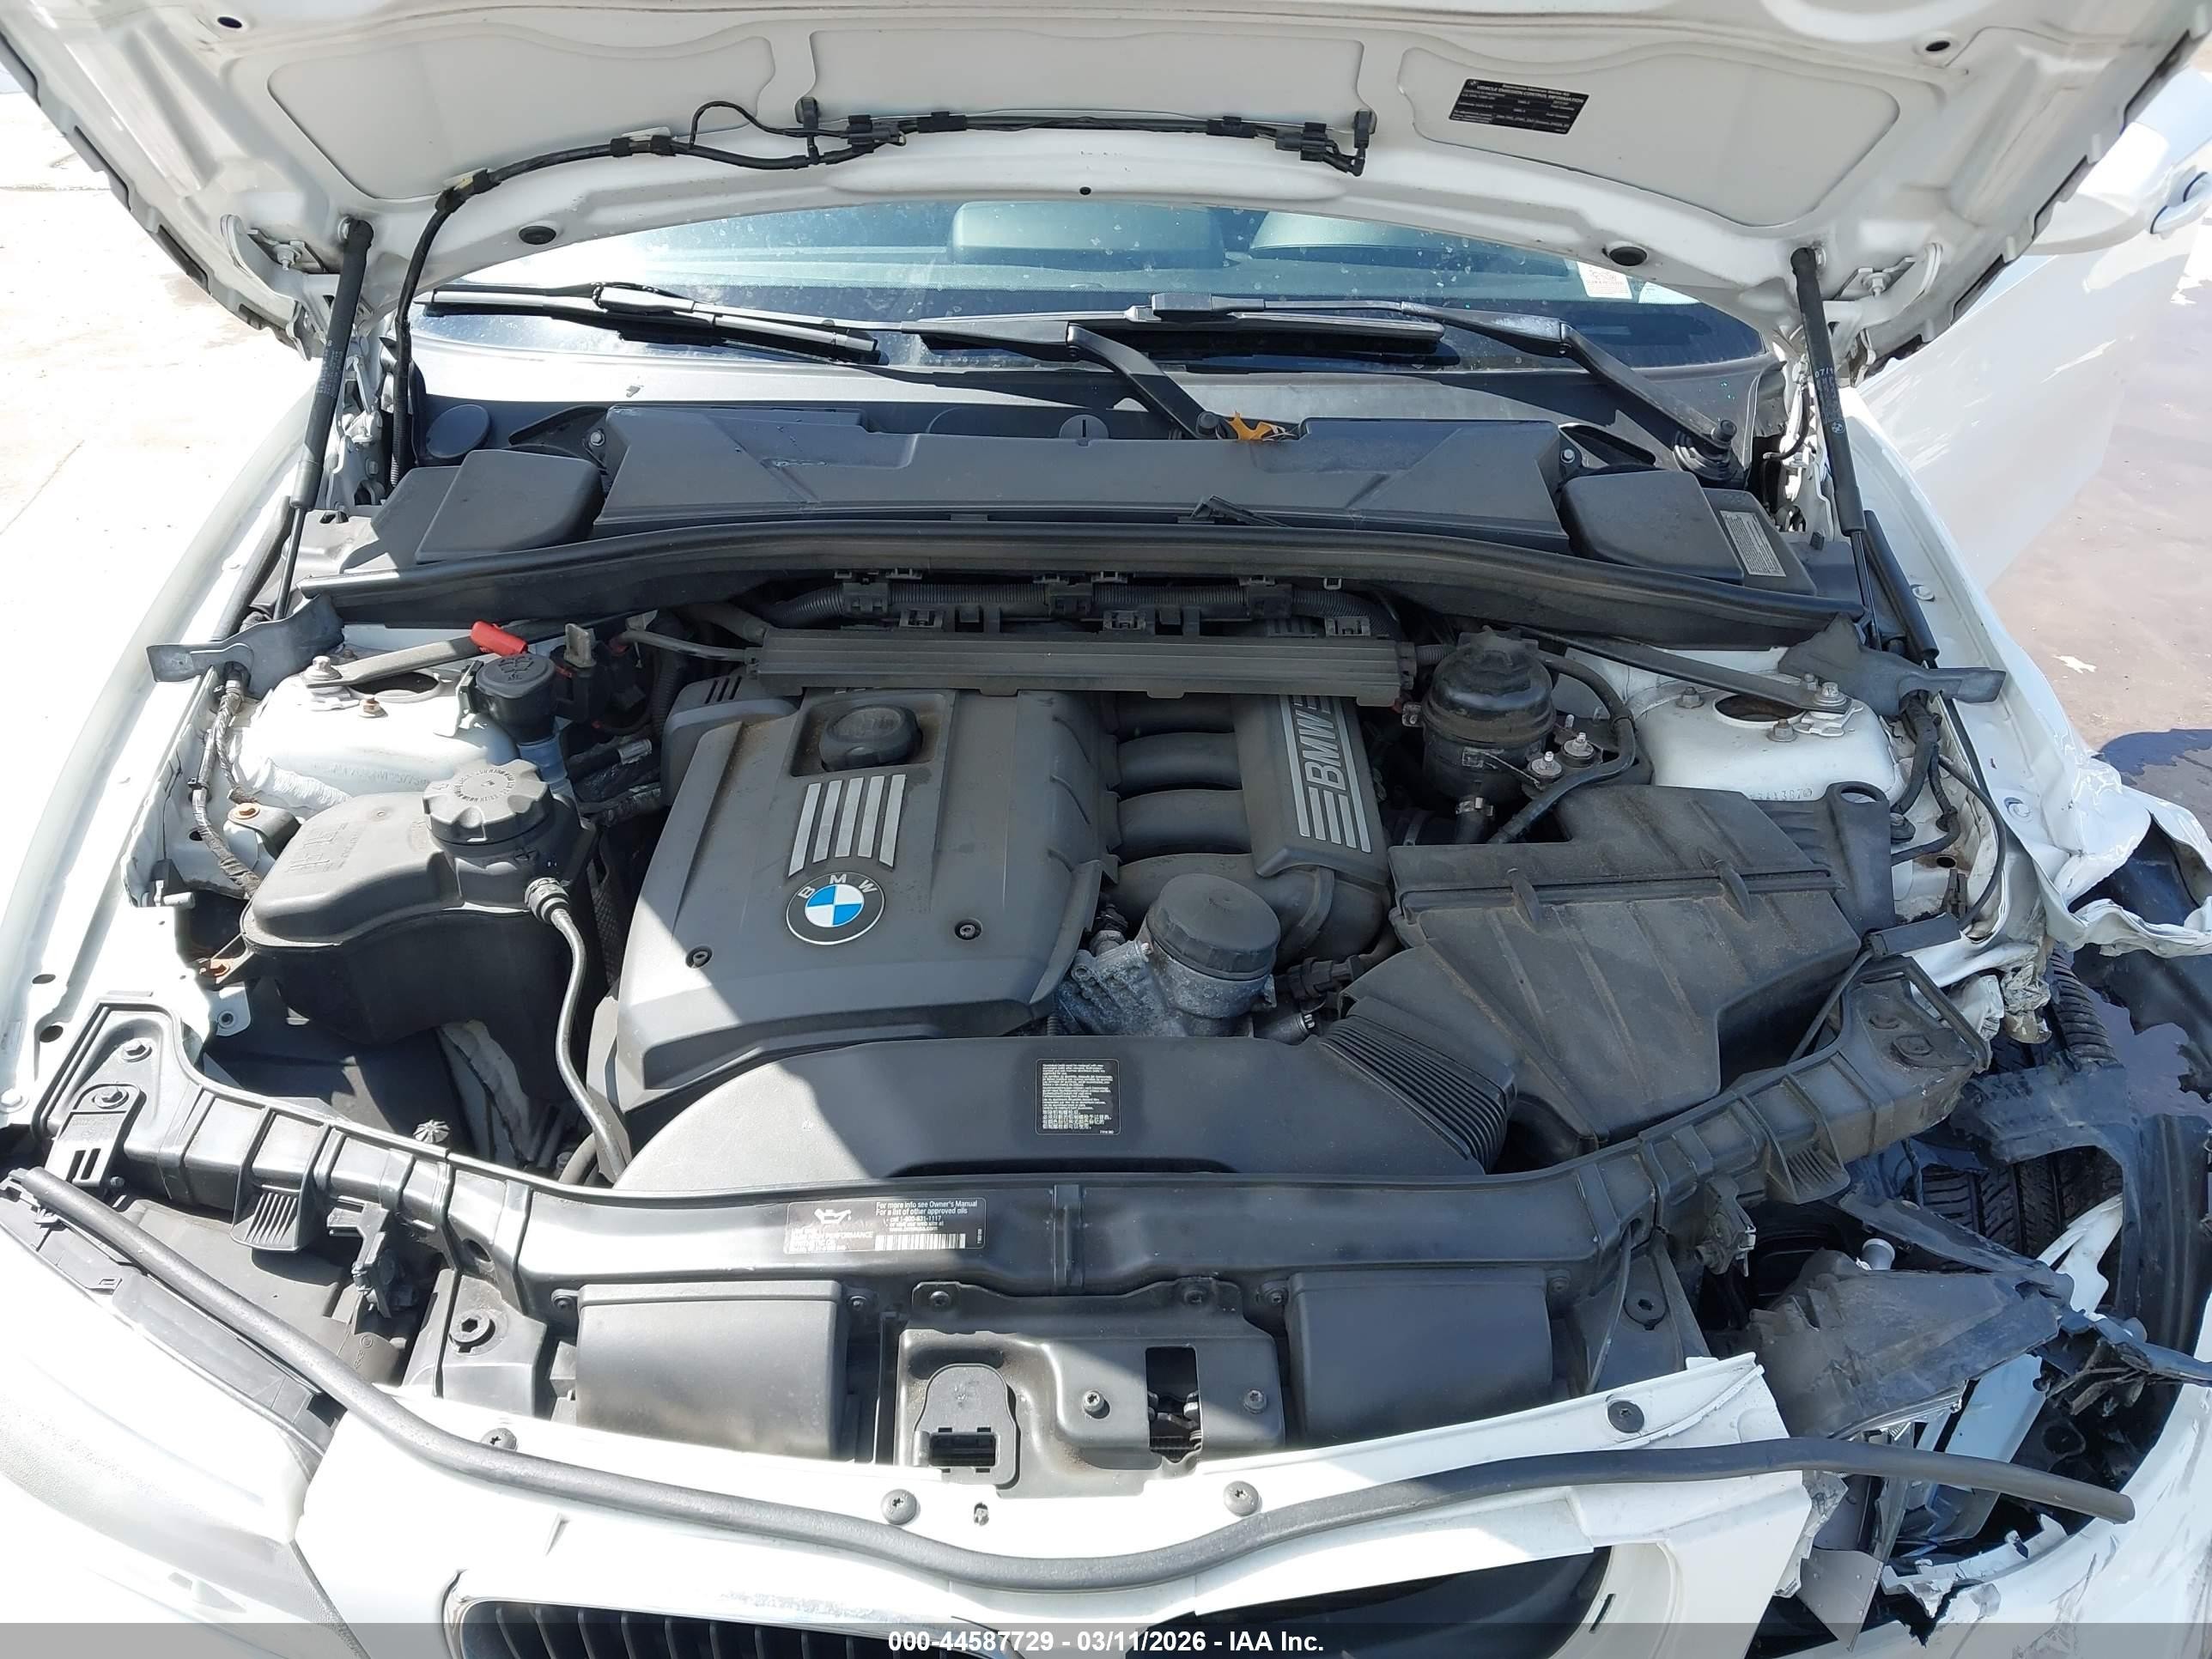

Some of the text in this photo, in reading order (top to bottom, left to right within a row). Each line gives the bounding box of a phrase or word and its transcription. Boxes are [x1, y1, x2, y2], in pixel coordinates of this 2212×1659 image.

[1548, 94, 1583, 103] INFORMATION
[1296, 709, 1346, 790] BMW
[798, 873, 878, 899] BMW
[927, 1207, 956, 1216] approved
